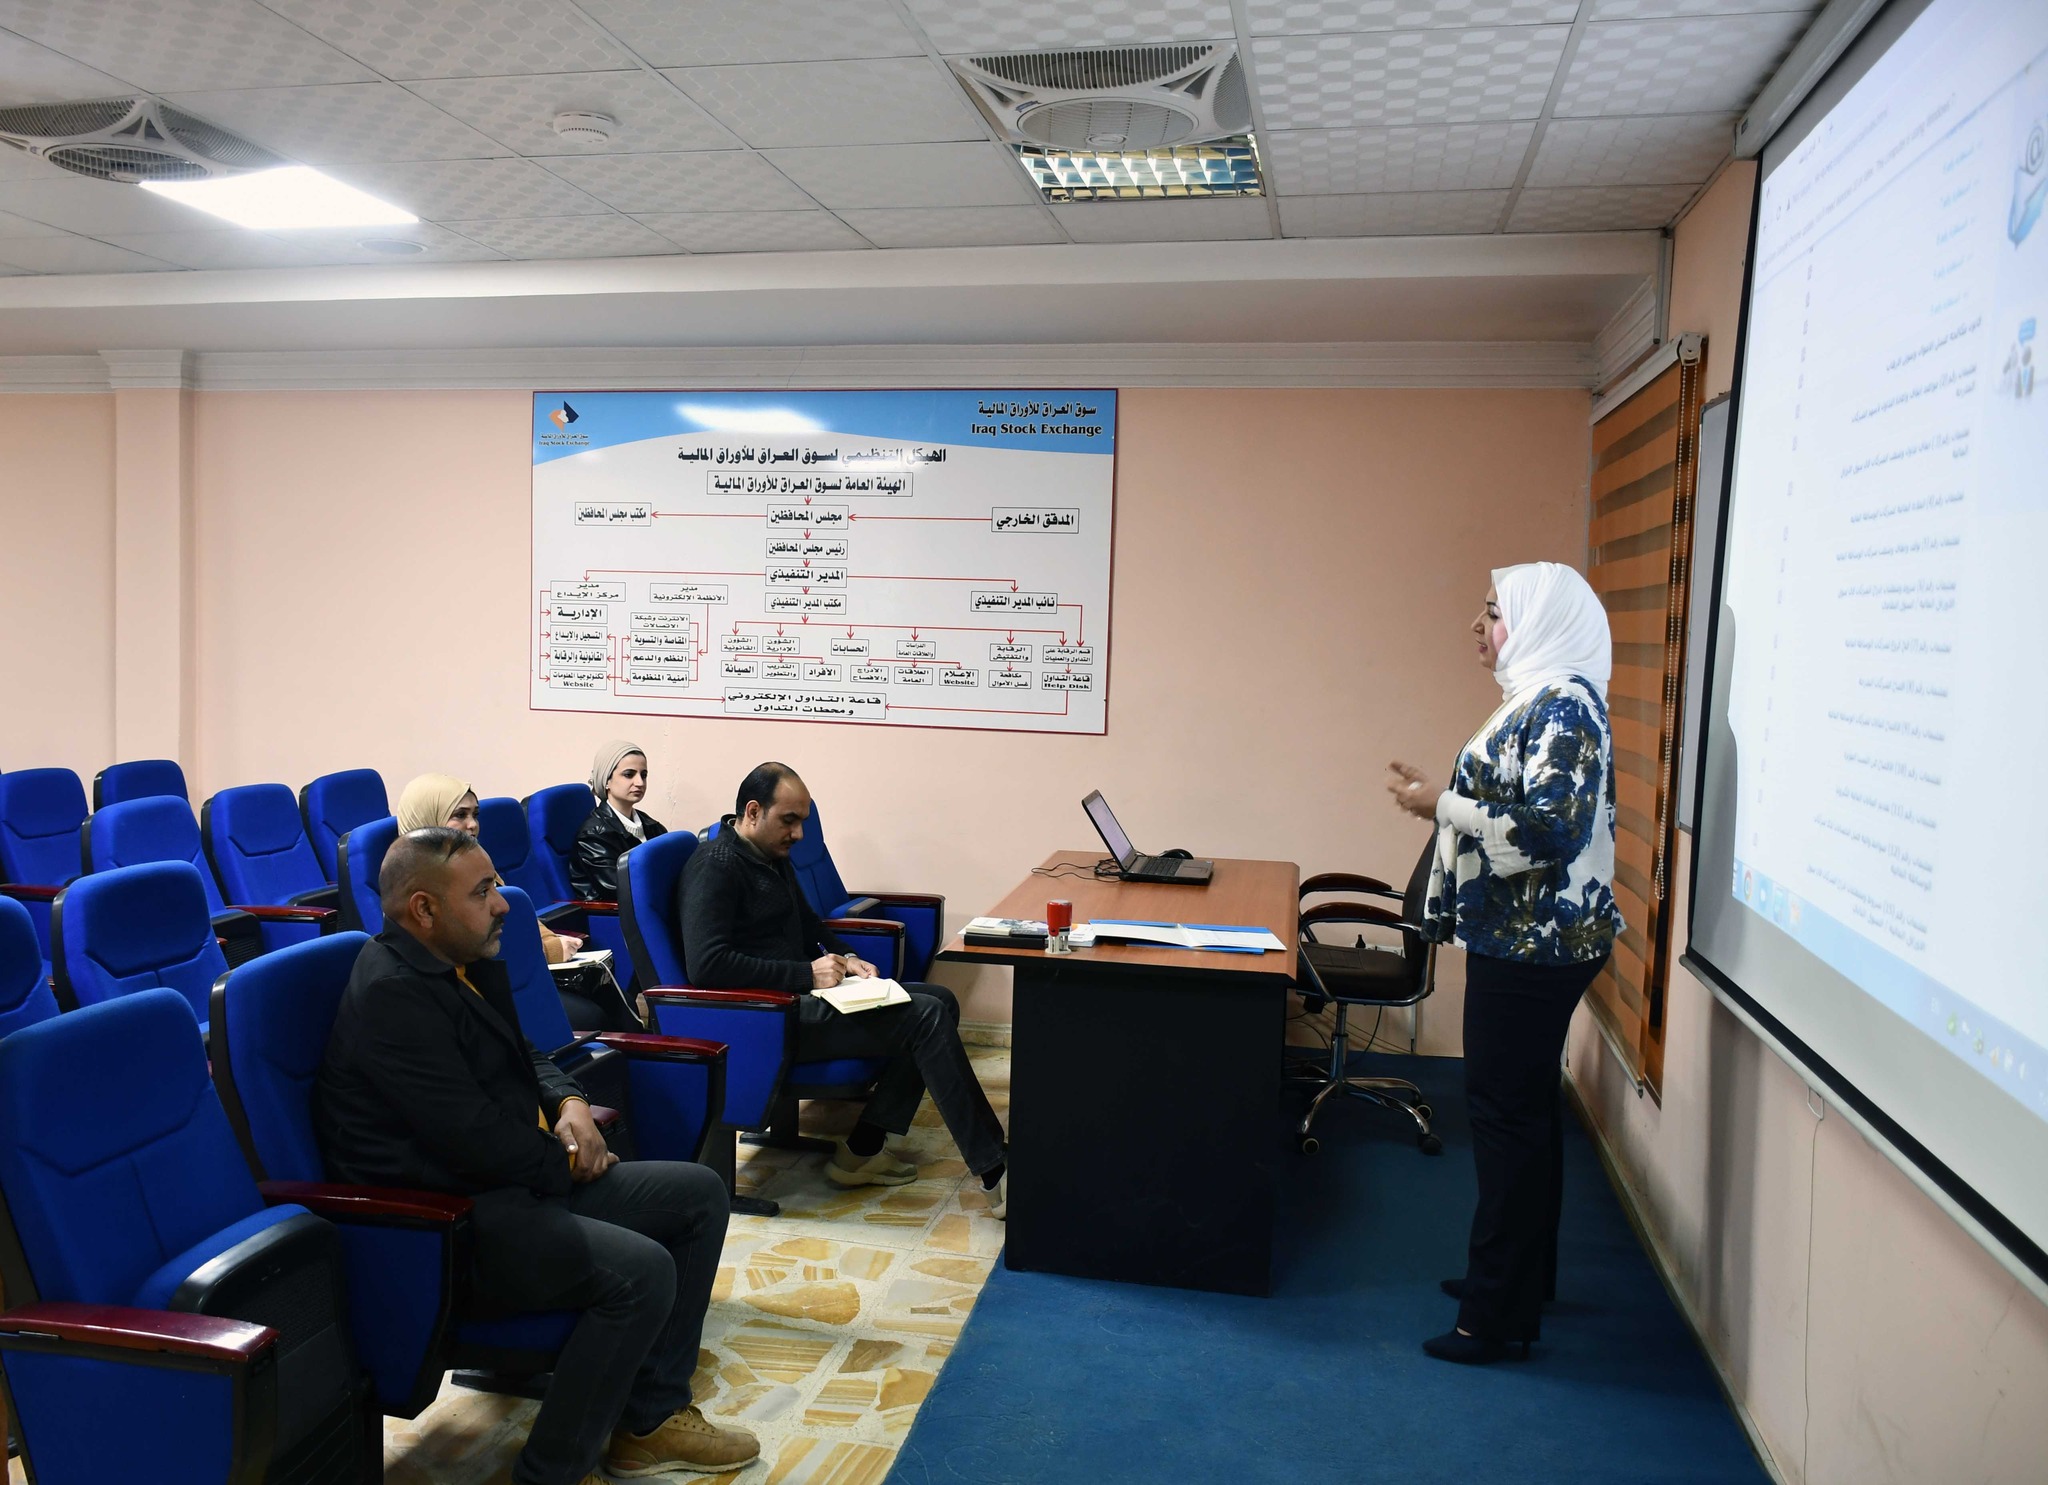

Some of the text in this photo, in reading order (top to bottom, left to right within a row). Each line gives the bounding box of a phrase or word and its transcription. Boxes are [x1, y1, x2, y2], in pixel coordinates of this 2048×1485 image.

[978, 401, 1097, 418] سوق العراق للأوراق المالية
[971, 423, 1102, 437] Iraq Stock Exchange
[677, 445, 946, 468] الهيكل التنظيمي لسوق العراق للأوراق المالية
[714, 475, 906, 495] الهيئة العامة لسوق العراق للأوراق المالية
[578, 506, 646, 522] مكتب مجلس المحافظين
[770, 509, 842, 525] مجلس المحافظين
[996, 513, 1074, 530] المدقق الخارجي
[768, 542, 845, 556] رئيس مجلس المحافظين
[770, 568, 843, 583] المدير التنفيذي
[770, 597, 842, 610] مكتب المدير التنفيذي
[975, 595, 1055, 610] نائب المدير التنفيذي
[556, 606, 602, 621] الإدارية
[580, 631, 603, 642] التسجيل
[634, 634, 687, 646] المقاصة والتسوية
[832, 644, 867, 655] الحسابات
[996, 645, 1026, 653] الرقابة
[554, 649, 604, 664] القانونية والرقابة
[633, 654, 687, 663] النظم والدعم
[992, 653, 1029, 661] والتفتيش
[724, 663, 754, 676] الصيانة
[944, 670, 975, 679] الإعلام
[632, 672, 664, 682] المنظومة
[1043, 674, 1071, 683] التداول
[727, 691, 881, 705] قاعة التداول الإلكتروني
[753, 704, 798, 713] التداول
